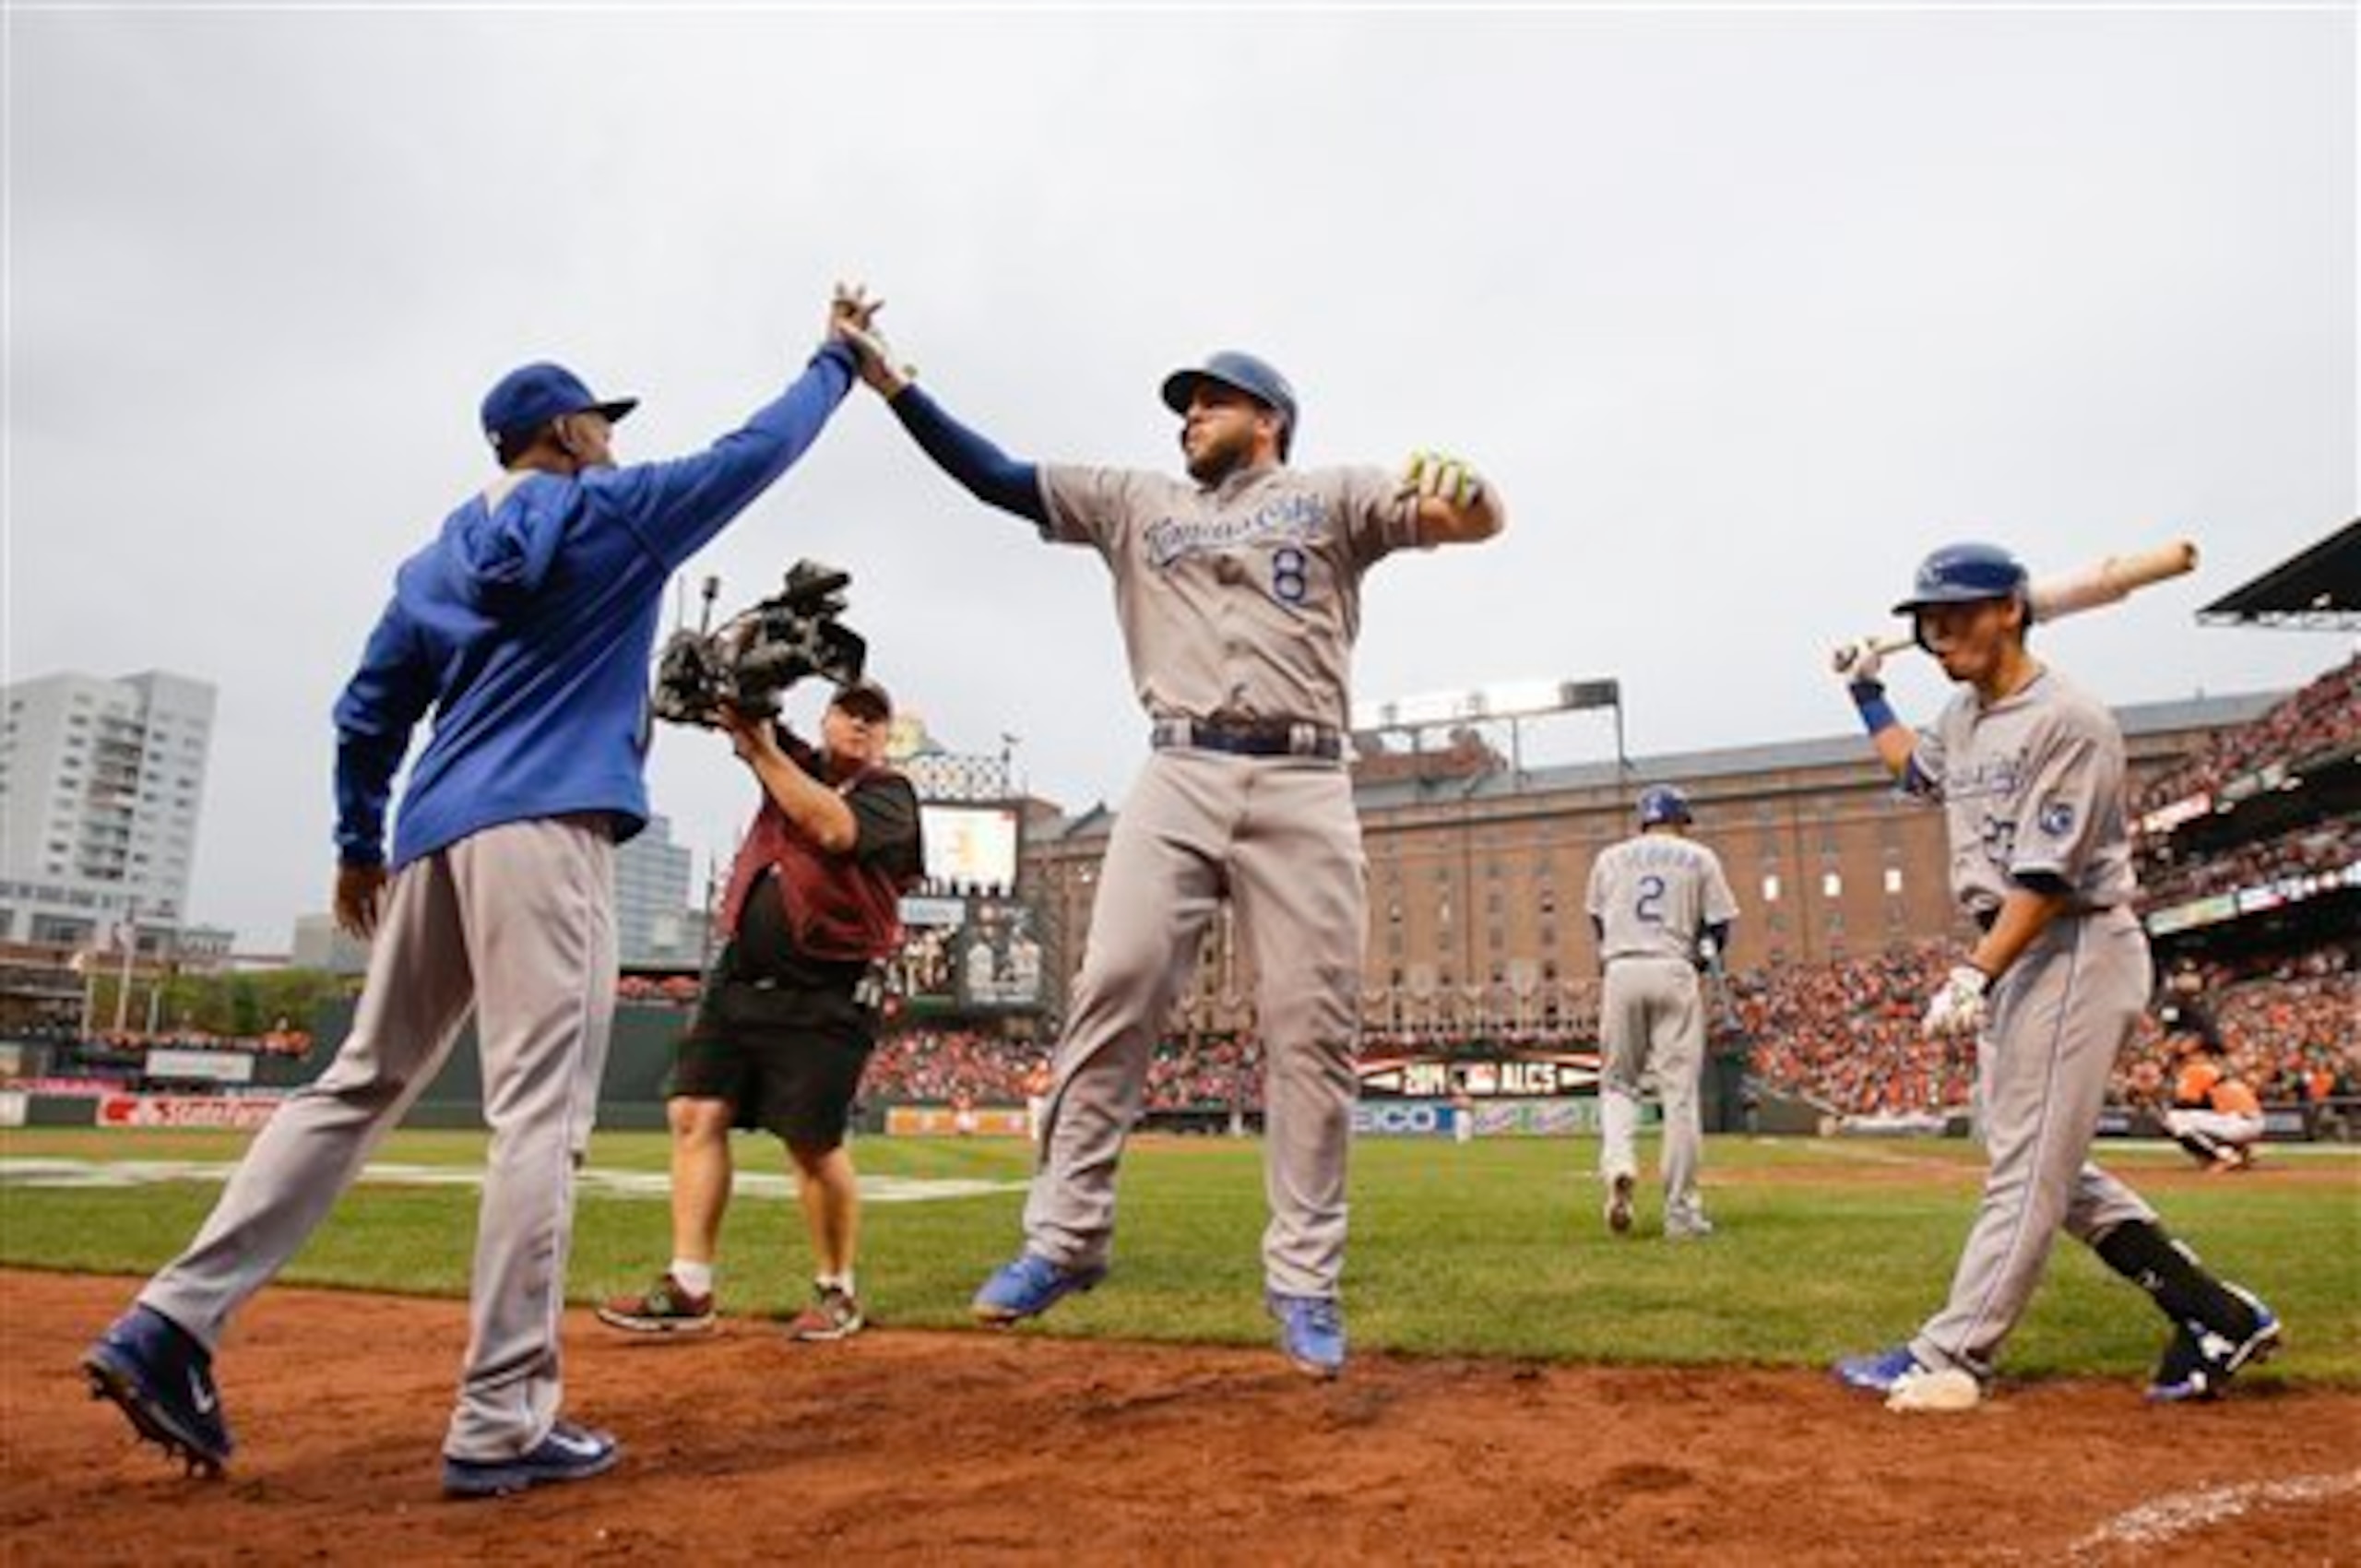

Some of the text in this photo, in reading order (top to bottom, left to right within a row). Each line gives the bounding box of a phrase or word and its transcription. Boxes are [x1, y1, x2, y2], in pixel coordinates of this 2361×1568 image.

[1273, 548, 1305, 601] 8
[1635, 875, 1665, 921] 2
[1348, 1105, 1436, 1132] EICO
